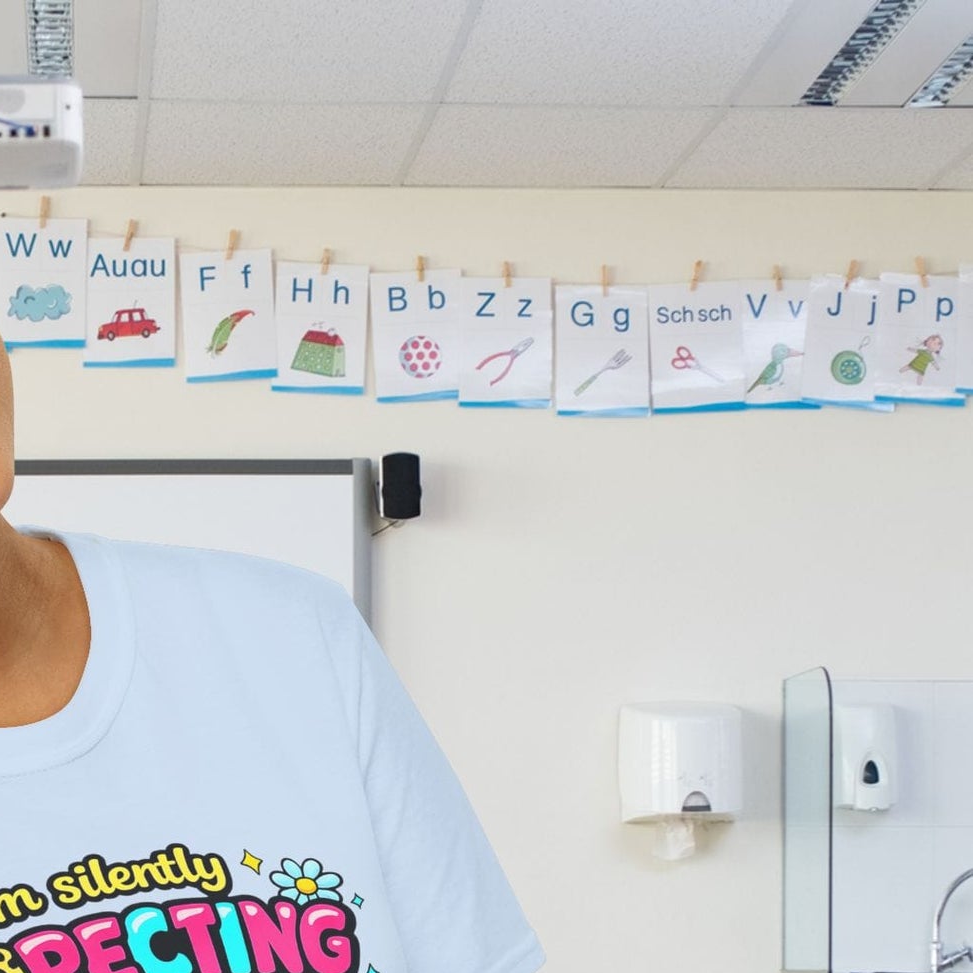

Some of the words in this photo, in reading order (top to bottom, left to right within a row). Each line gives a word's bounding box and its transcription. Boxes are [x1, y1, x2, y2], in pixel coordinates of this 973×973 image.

[6, 233, 37, 257] W
[49, 240, 72, 258] w
[199, 266, 216, 291] F
[241, 264, 252, 289] f
[291, 278, 313, 303] H
[333, 280, 350, 304] h
[388, 286, 408, 312] B
[428, 285, 446, 309] b
[475, 292, 496, 318] Z
[517, 298, 533, 318] z
[746, 294, 768, 319] V
[788, 300, 804, 318] v
[827, 292, 842, 317] J
[867, 295, 877, 325] j
[898, 288, 916, 313] P
[936, 297, 954, 322] p
[571, 301, 595, 327] G
[613, 307, 630, 332] g
[656, 306, 694, 324] Sch
[698, 304, 732, 322] sch
[52, 847, 226, 904] silently
